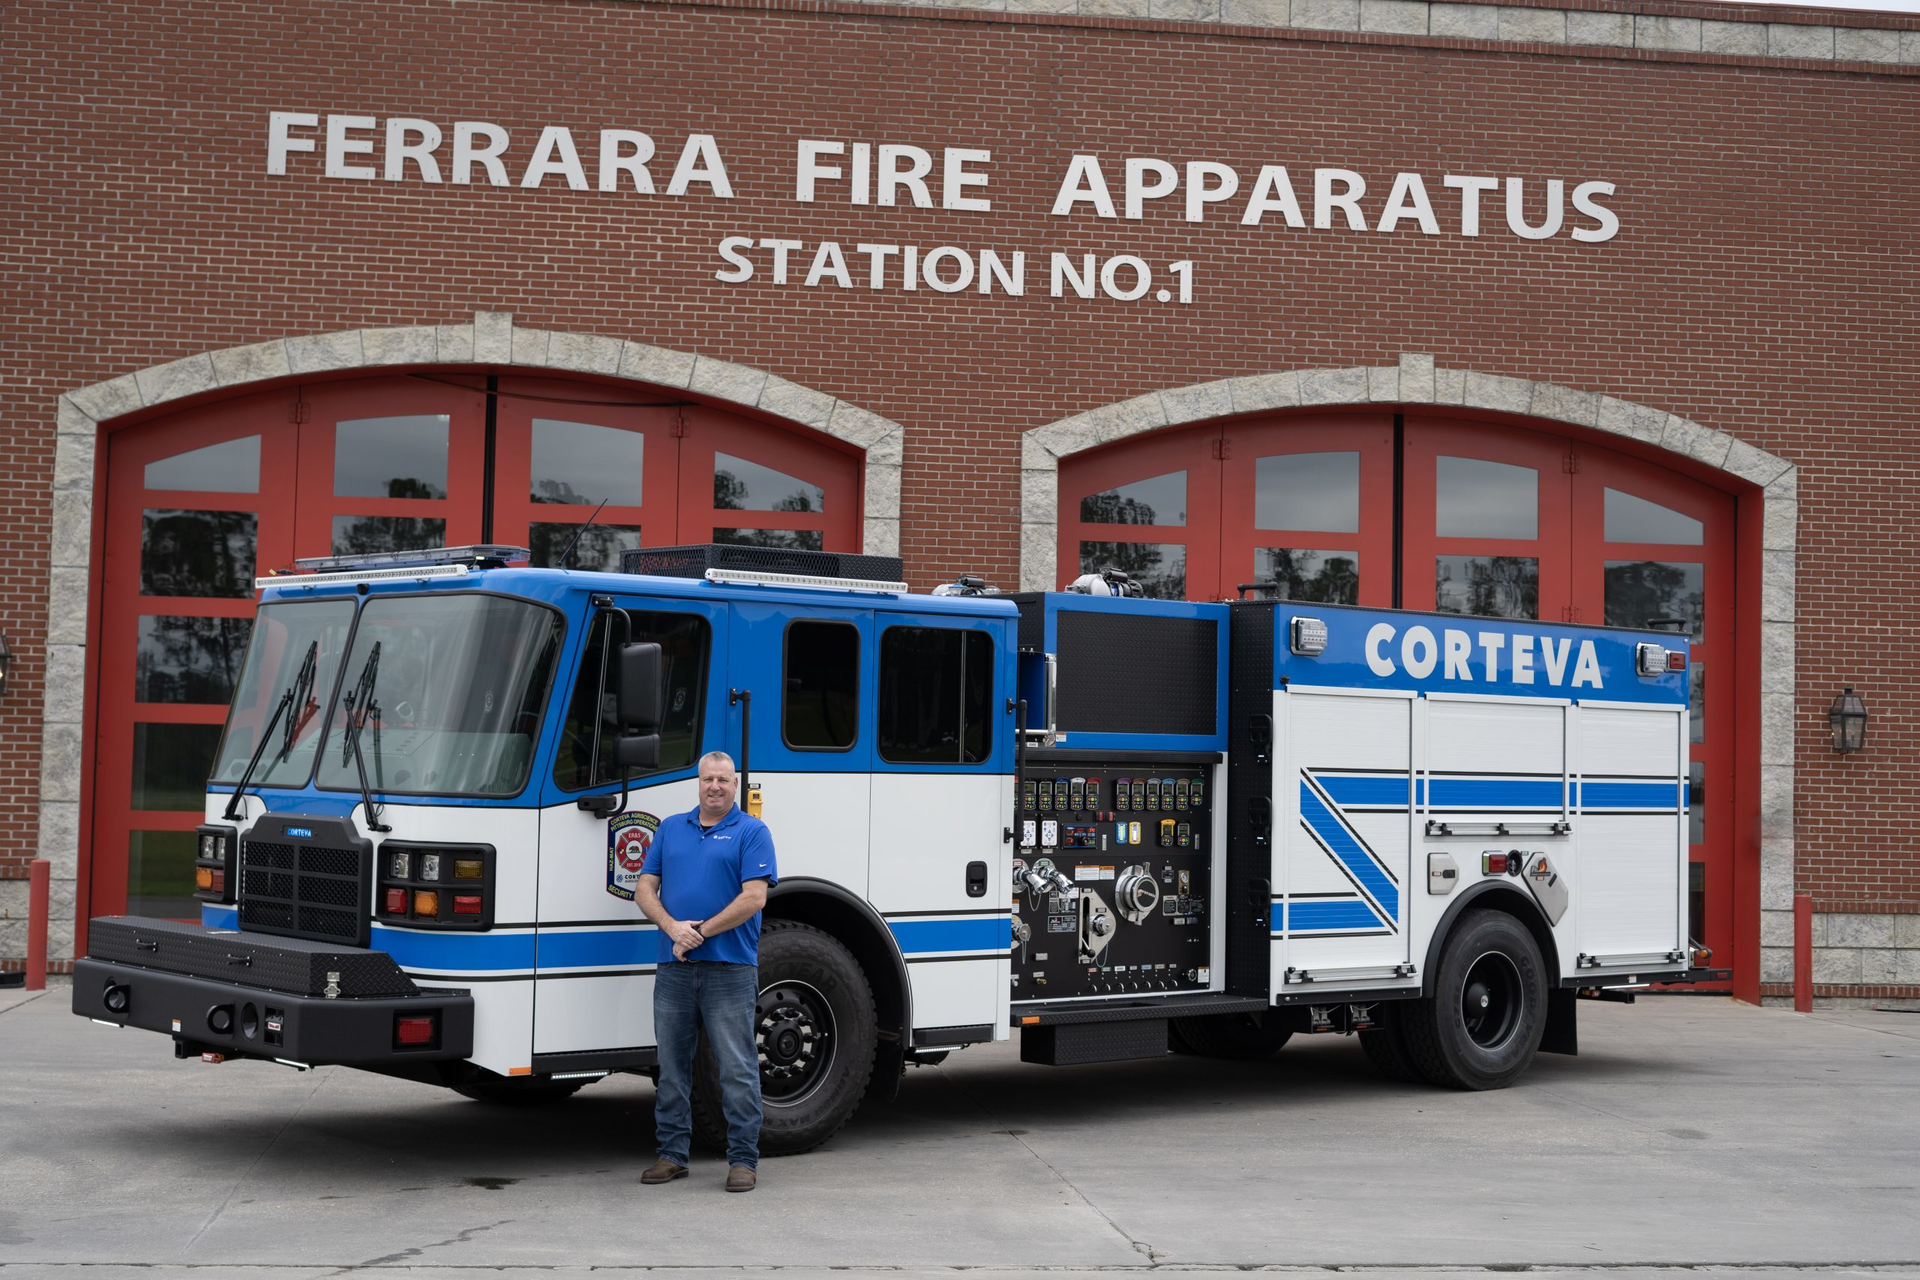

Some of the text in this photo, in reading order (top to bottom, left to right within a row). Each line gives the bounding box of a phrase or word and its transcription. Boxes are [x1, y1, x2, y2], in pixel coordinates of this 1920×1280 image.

[266, 110, 1621, 244] FERRARA FIRE APPARATUS
[715, 236, 1193, 304] STATION NO.1
[1365, 622, 1604, 689] CORTEVA
[287, 828, 312, 838] CORTEVA
[608, 885, 633, 898] SECURITY
